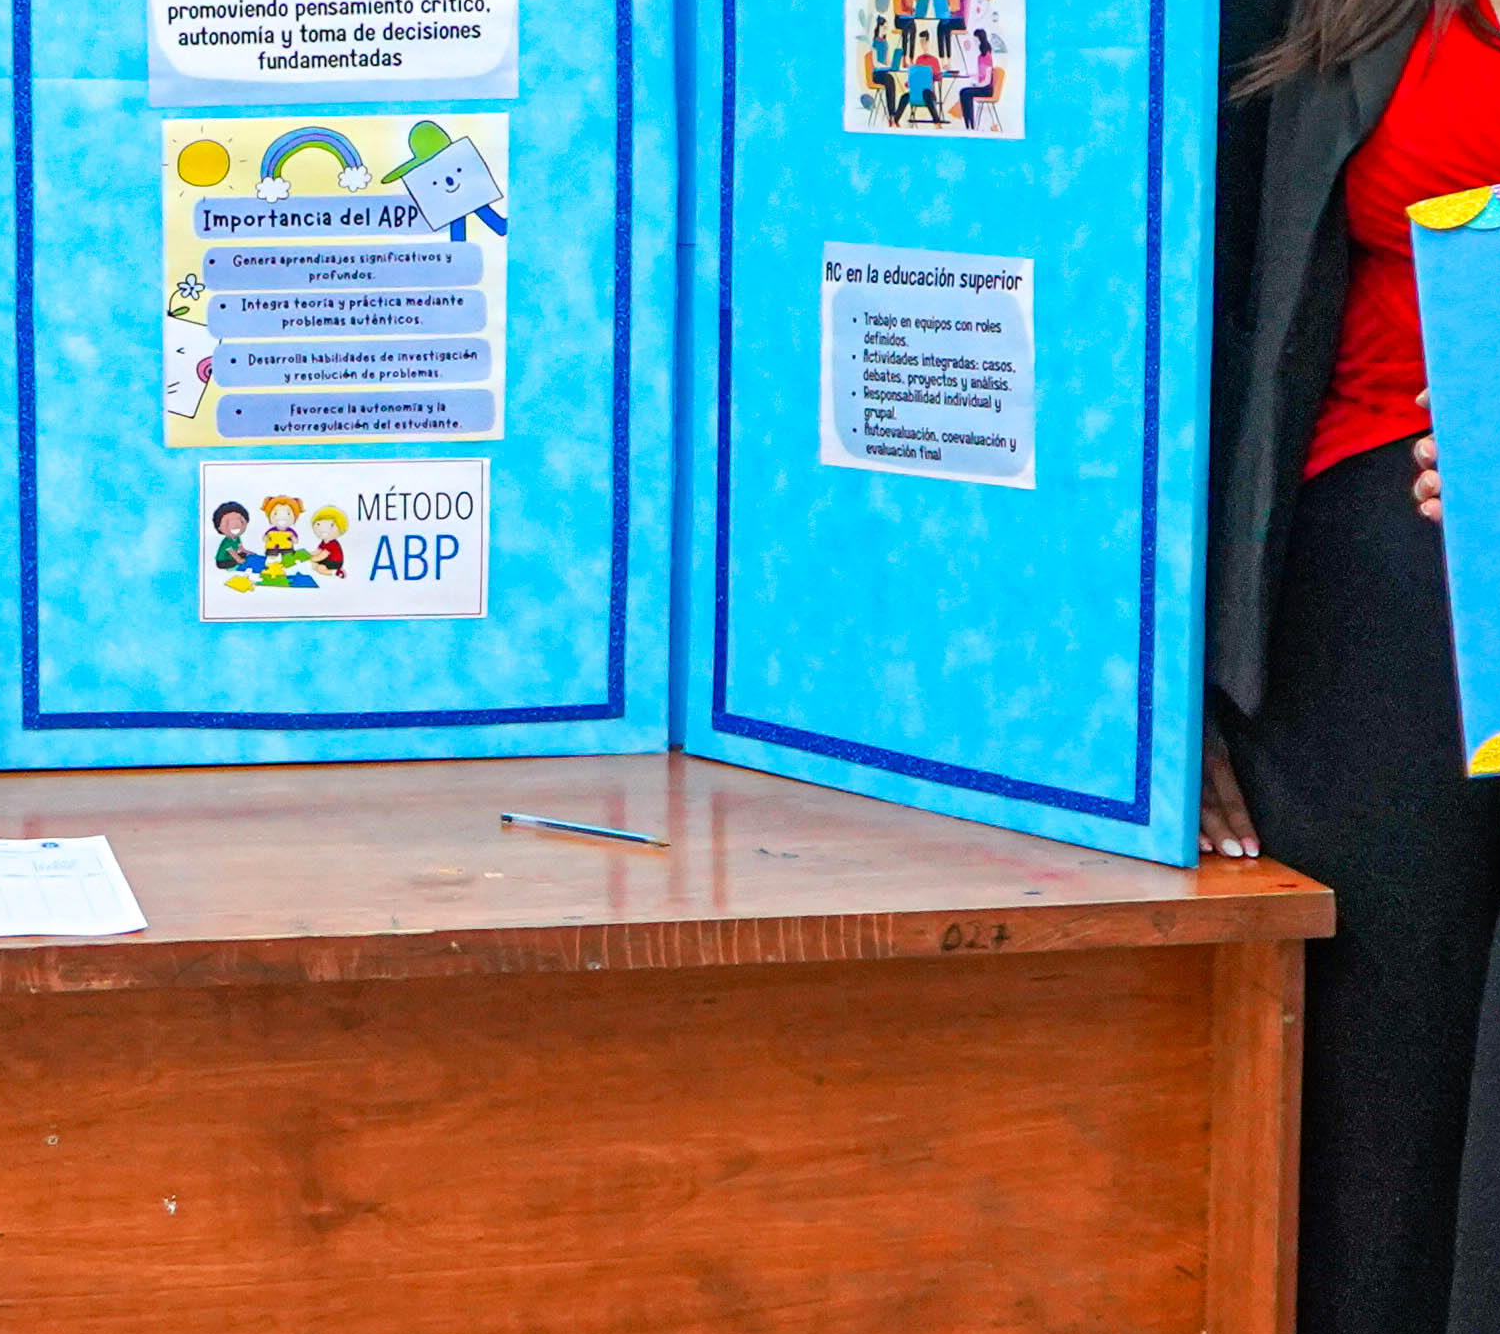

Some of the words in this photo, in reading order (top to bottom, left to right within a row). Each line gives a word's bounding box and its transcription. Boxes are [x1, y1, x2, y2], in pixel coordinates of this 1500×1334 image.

[168, 0, 288, 25] promoviendo
[179, 26, 274, 45] autonomía
[282, 30, 292, 48] y
[300, 25, 346, 42] toma
[354, 23, 375, 41] de
[383, 22, 481, 40] decisiones
[258, 48, 402, 69] fundamentadas
[358, 486, 473, 521] MÉTODO
[370, 535, 459, 581] ABP
